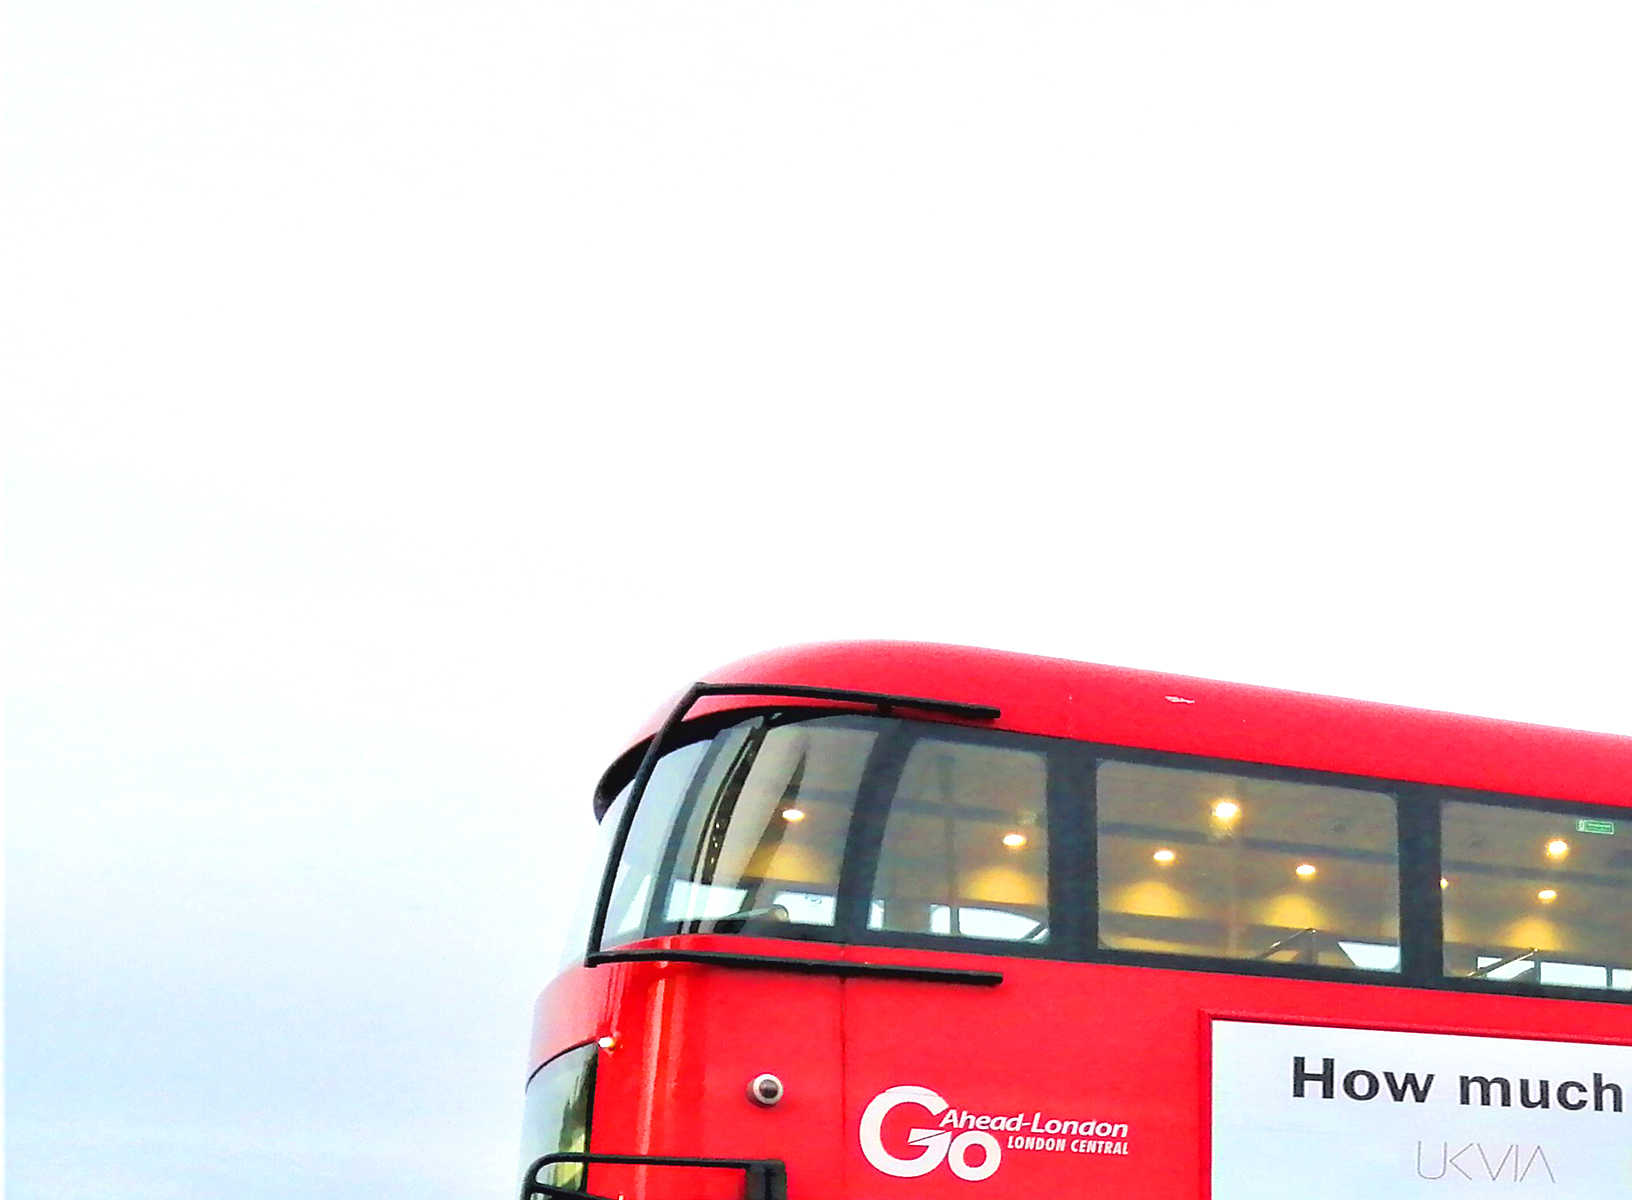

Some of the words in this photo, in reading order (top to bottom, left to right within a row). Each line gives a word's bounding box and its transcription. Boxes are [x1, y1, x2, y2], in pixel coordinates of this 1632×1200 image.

[1293, 1056, 1435, 1103] How
[1460, 1072, 1623, 1113] much
[859, 1085, 1001, 1181] Go
[1007, 1135, 1067, 1152] LONDON
[1070, 1139, 1129, 1155] CENTRAL
